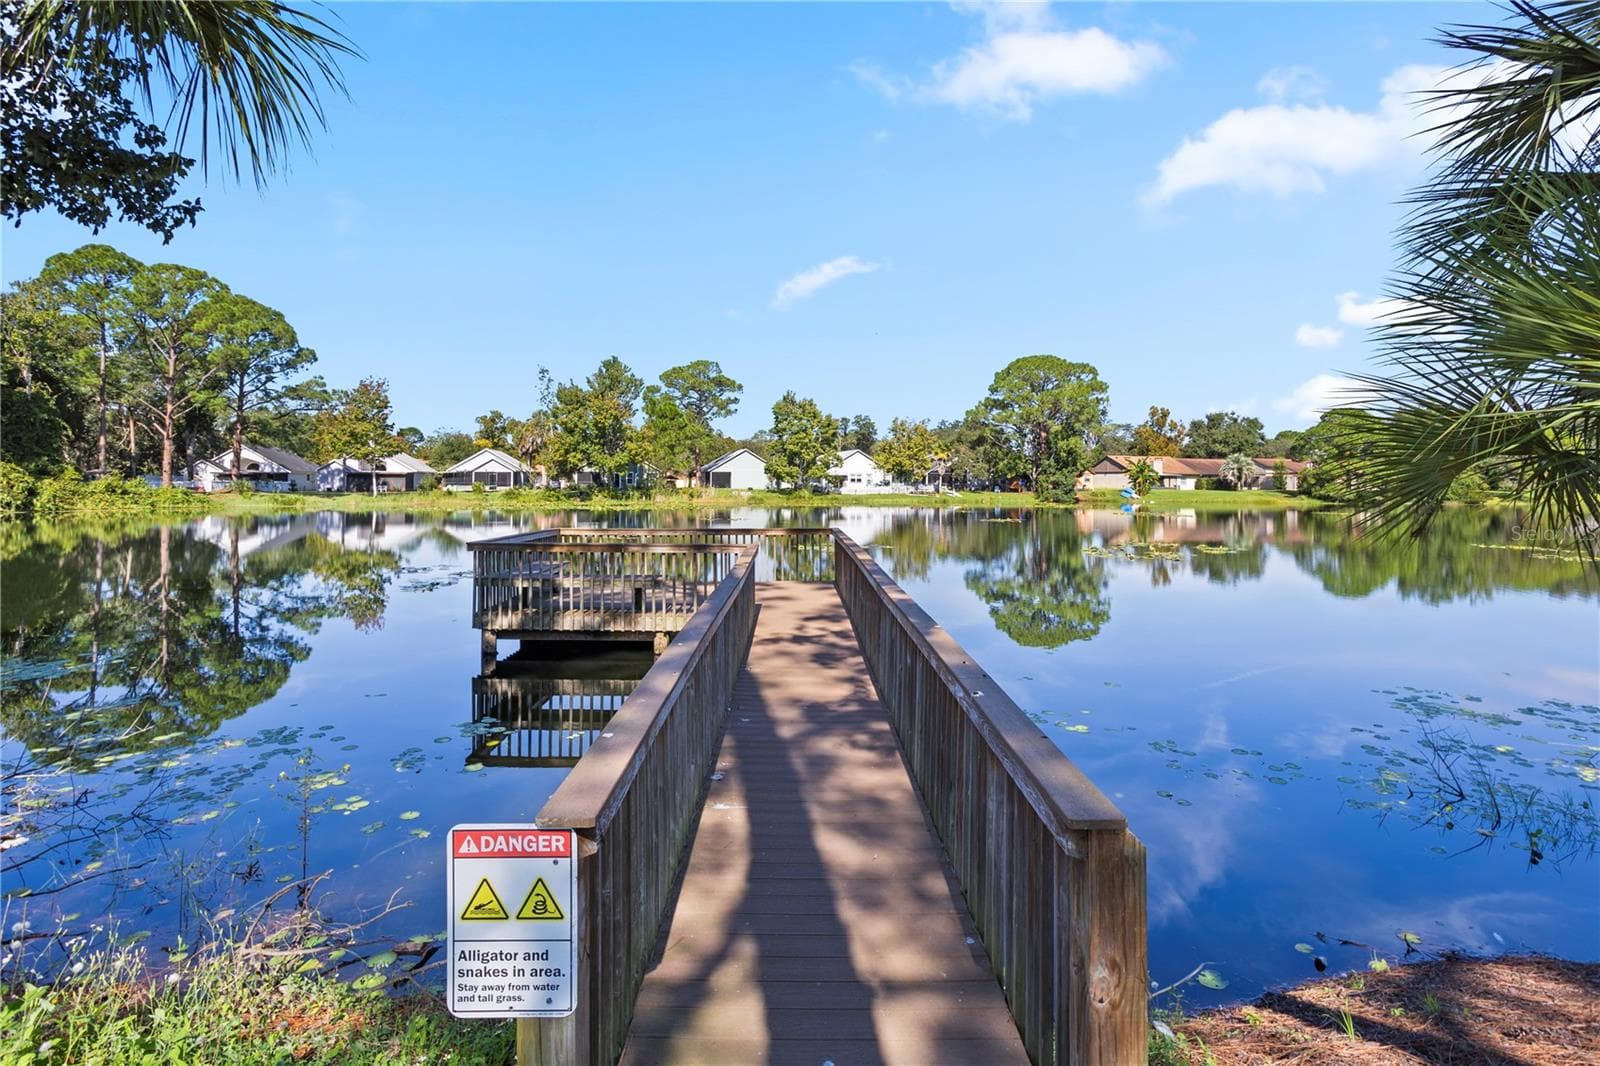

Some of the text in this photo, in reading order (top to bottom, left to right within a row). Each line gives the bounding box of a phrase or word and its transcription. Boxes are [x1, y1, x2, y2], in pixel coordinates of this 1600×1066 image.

[480, 835, 564, 852] DANGER
[458, 950, 549, 964] Alligator and
[458, 965, 566, 978] snakes in area.
[457, 983, 560, 993] Stay away from water
[457, 994, 525, 1004] and tall grass.
